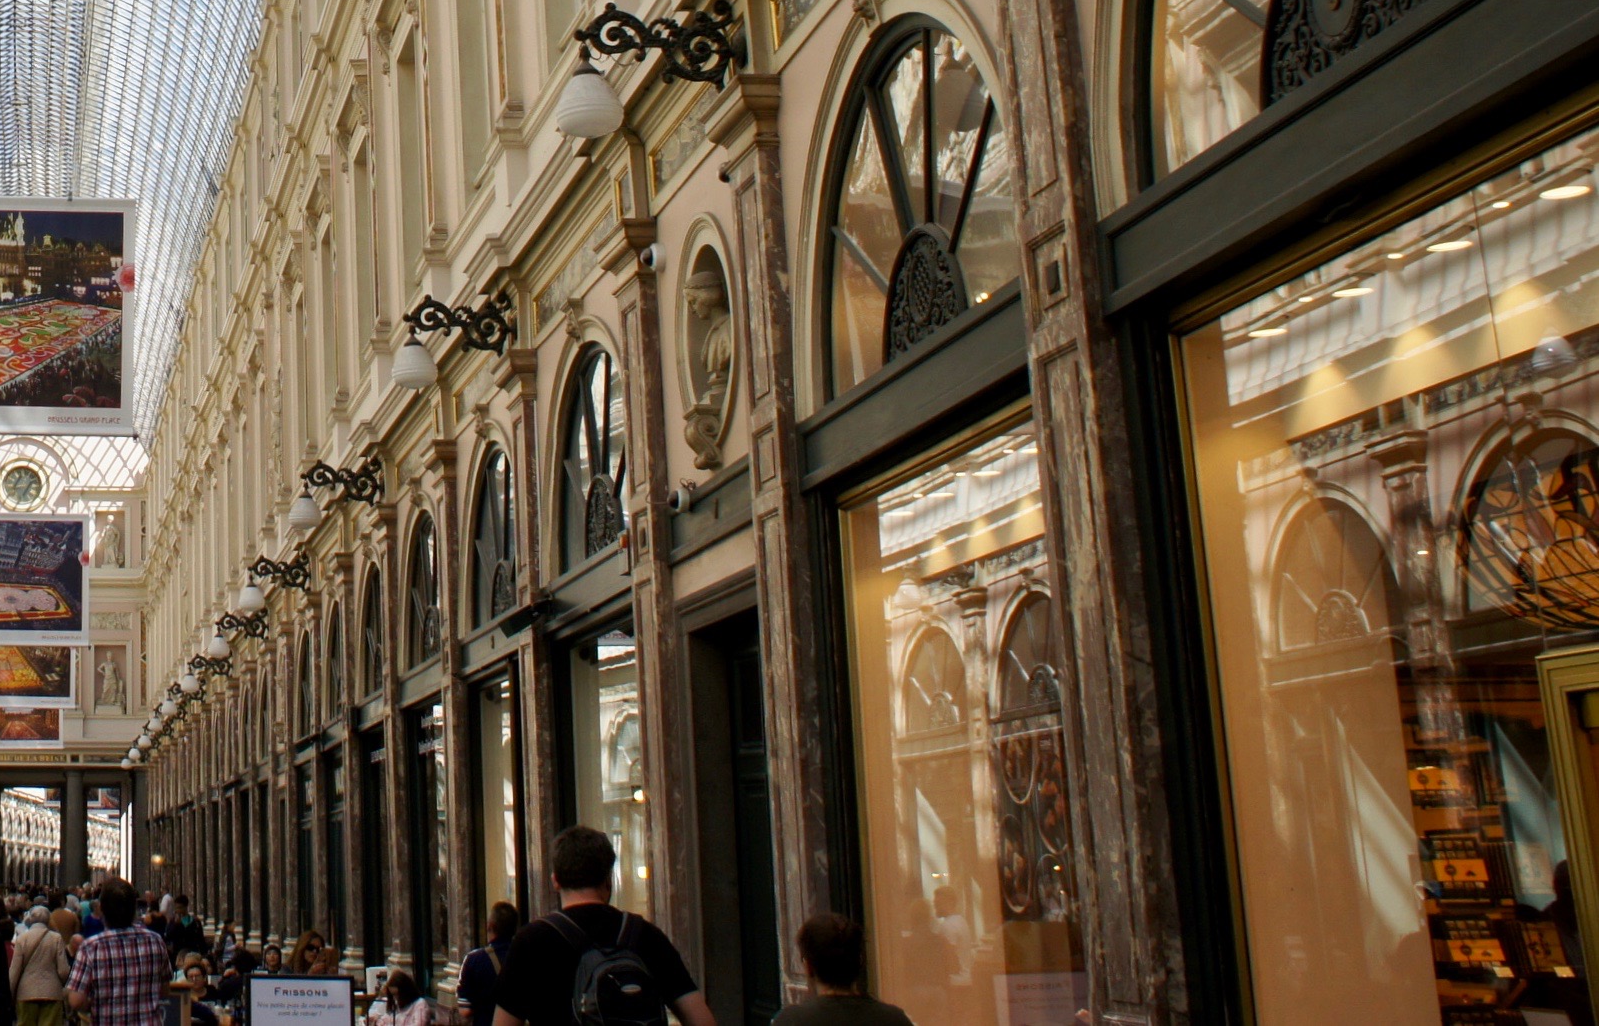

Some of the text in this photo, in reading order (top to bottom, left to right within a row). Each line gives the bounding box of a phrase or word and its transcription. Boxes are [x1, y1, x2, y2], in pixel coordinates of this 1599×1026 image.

[47, 416, 78, 424] BRUSSELS
[101, 416, 121, 424] PLACE
[14, 754, 26, 762] DE
